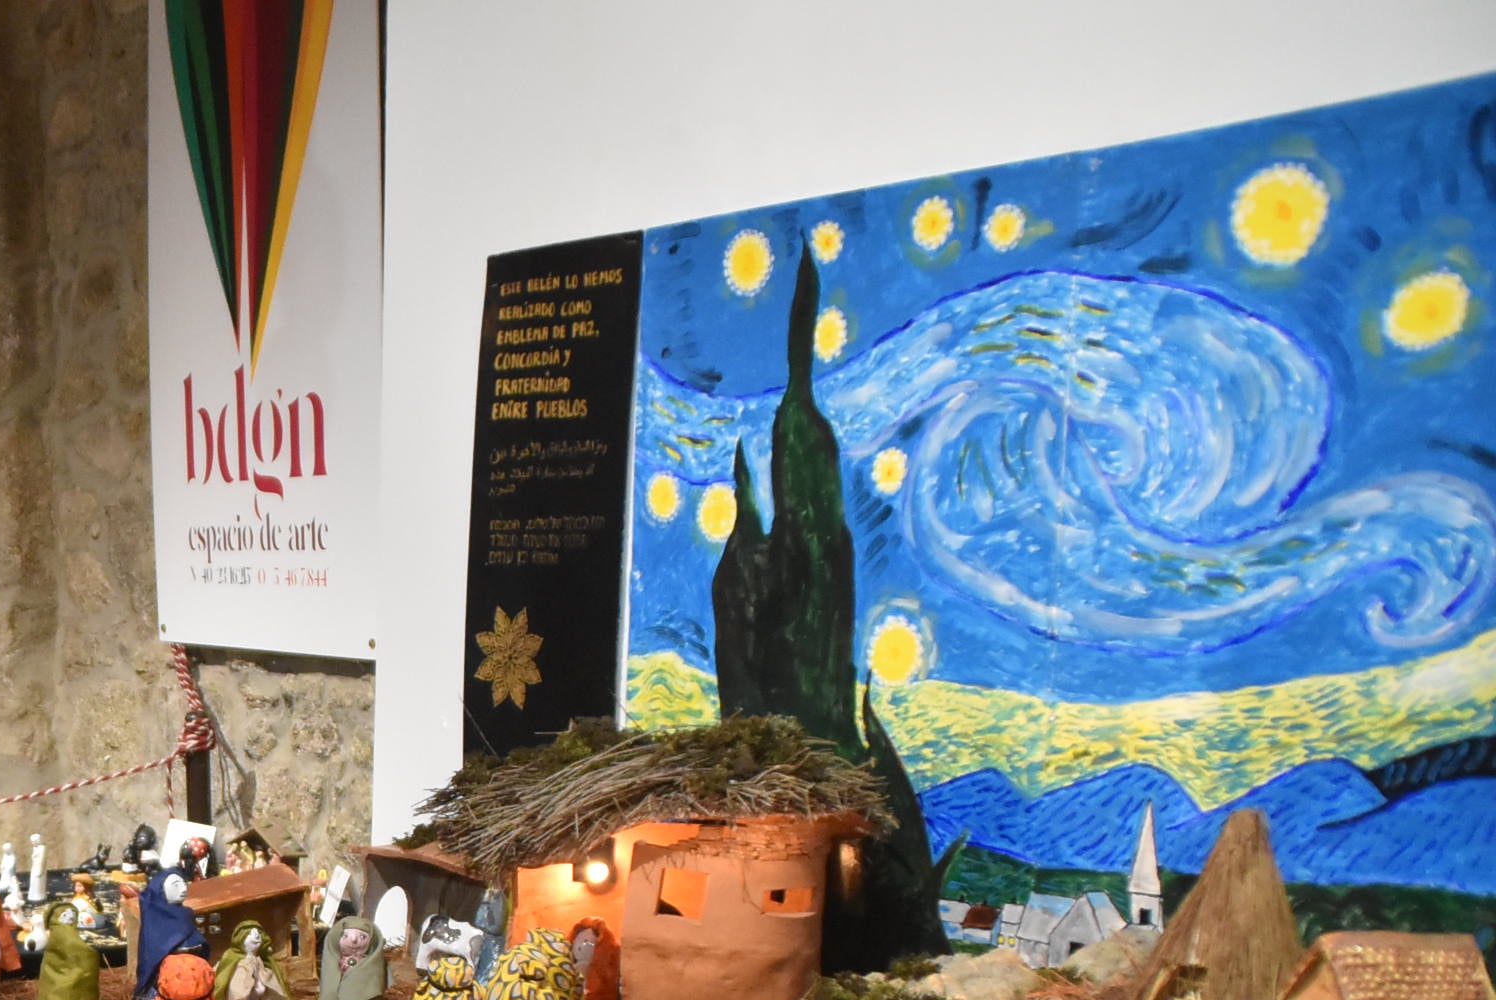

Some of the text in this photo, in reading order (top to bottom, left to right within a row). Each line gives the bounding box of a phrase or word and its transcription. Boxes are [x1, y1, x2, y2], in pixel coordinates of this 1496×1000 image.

[500, 269, 622, 296] ESTE BELÉN LO HEMOS
[560, 299, 592, 316] COMO
[496, 325, 550, 346] EMBLEMA
[553, 324, 566, 339] DE
[491, 399, 588, 421] ENTRE PUEBLOS
[187, 512, 329, 564] espacio de arte
